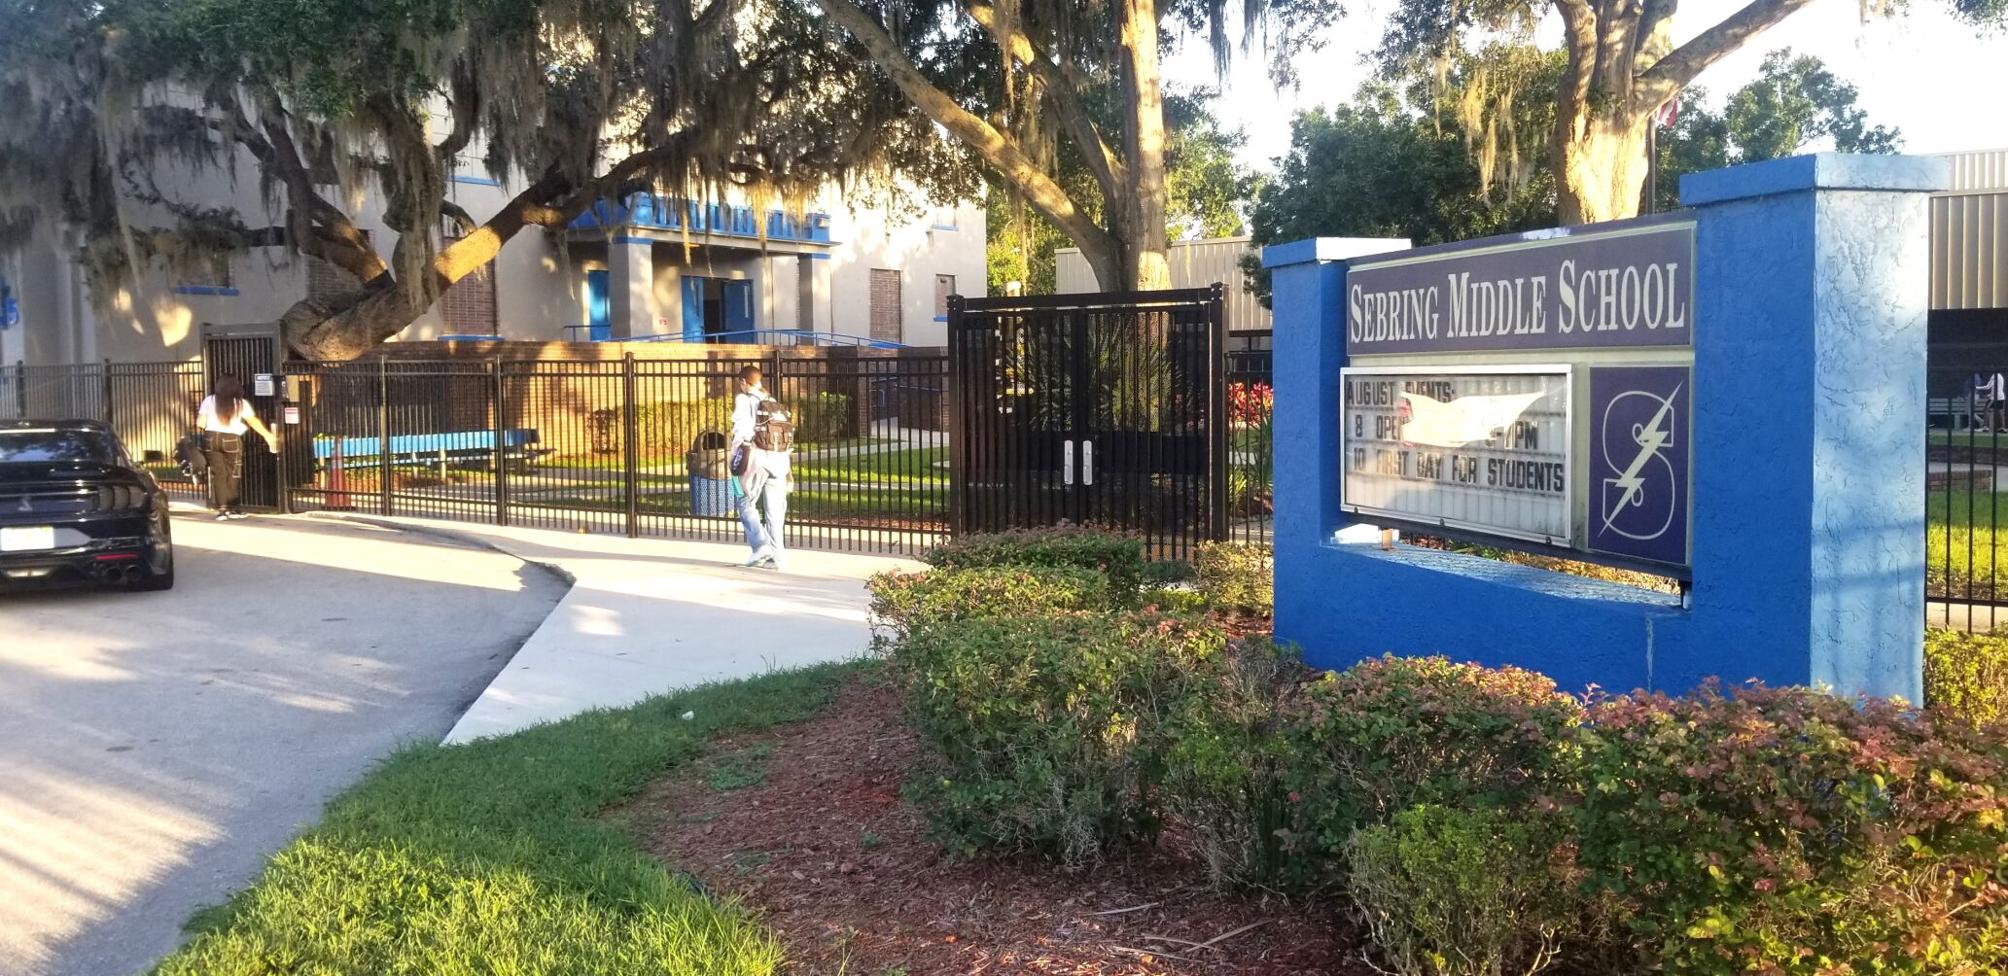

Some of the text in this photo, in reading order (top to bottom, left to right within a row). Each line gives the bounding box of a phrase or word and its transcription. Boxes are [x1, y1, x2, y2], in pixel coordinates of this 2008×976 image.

[1350, 259, 1686, 344] SEBRING MIDDLE SCHOOL
[1347, 381, 1396, 406] AUGUST
[1355, 414, 1363, 438] 8
[1354, 447, 1564, 492] 10 FIRST DAY FOR STUDENTS
